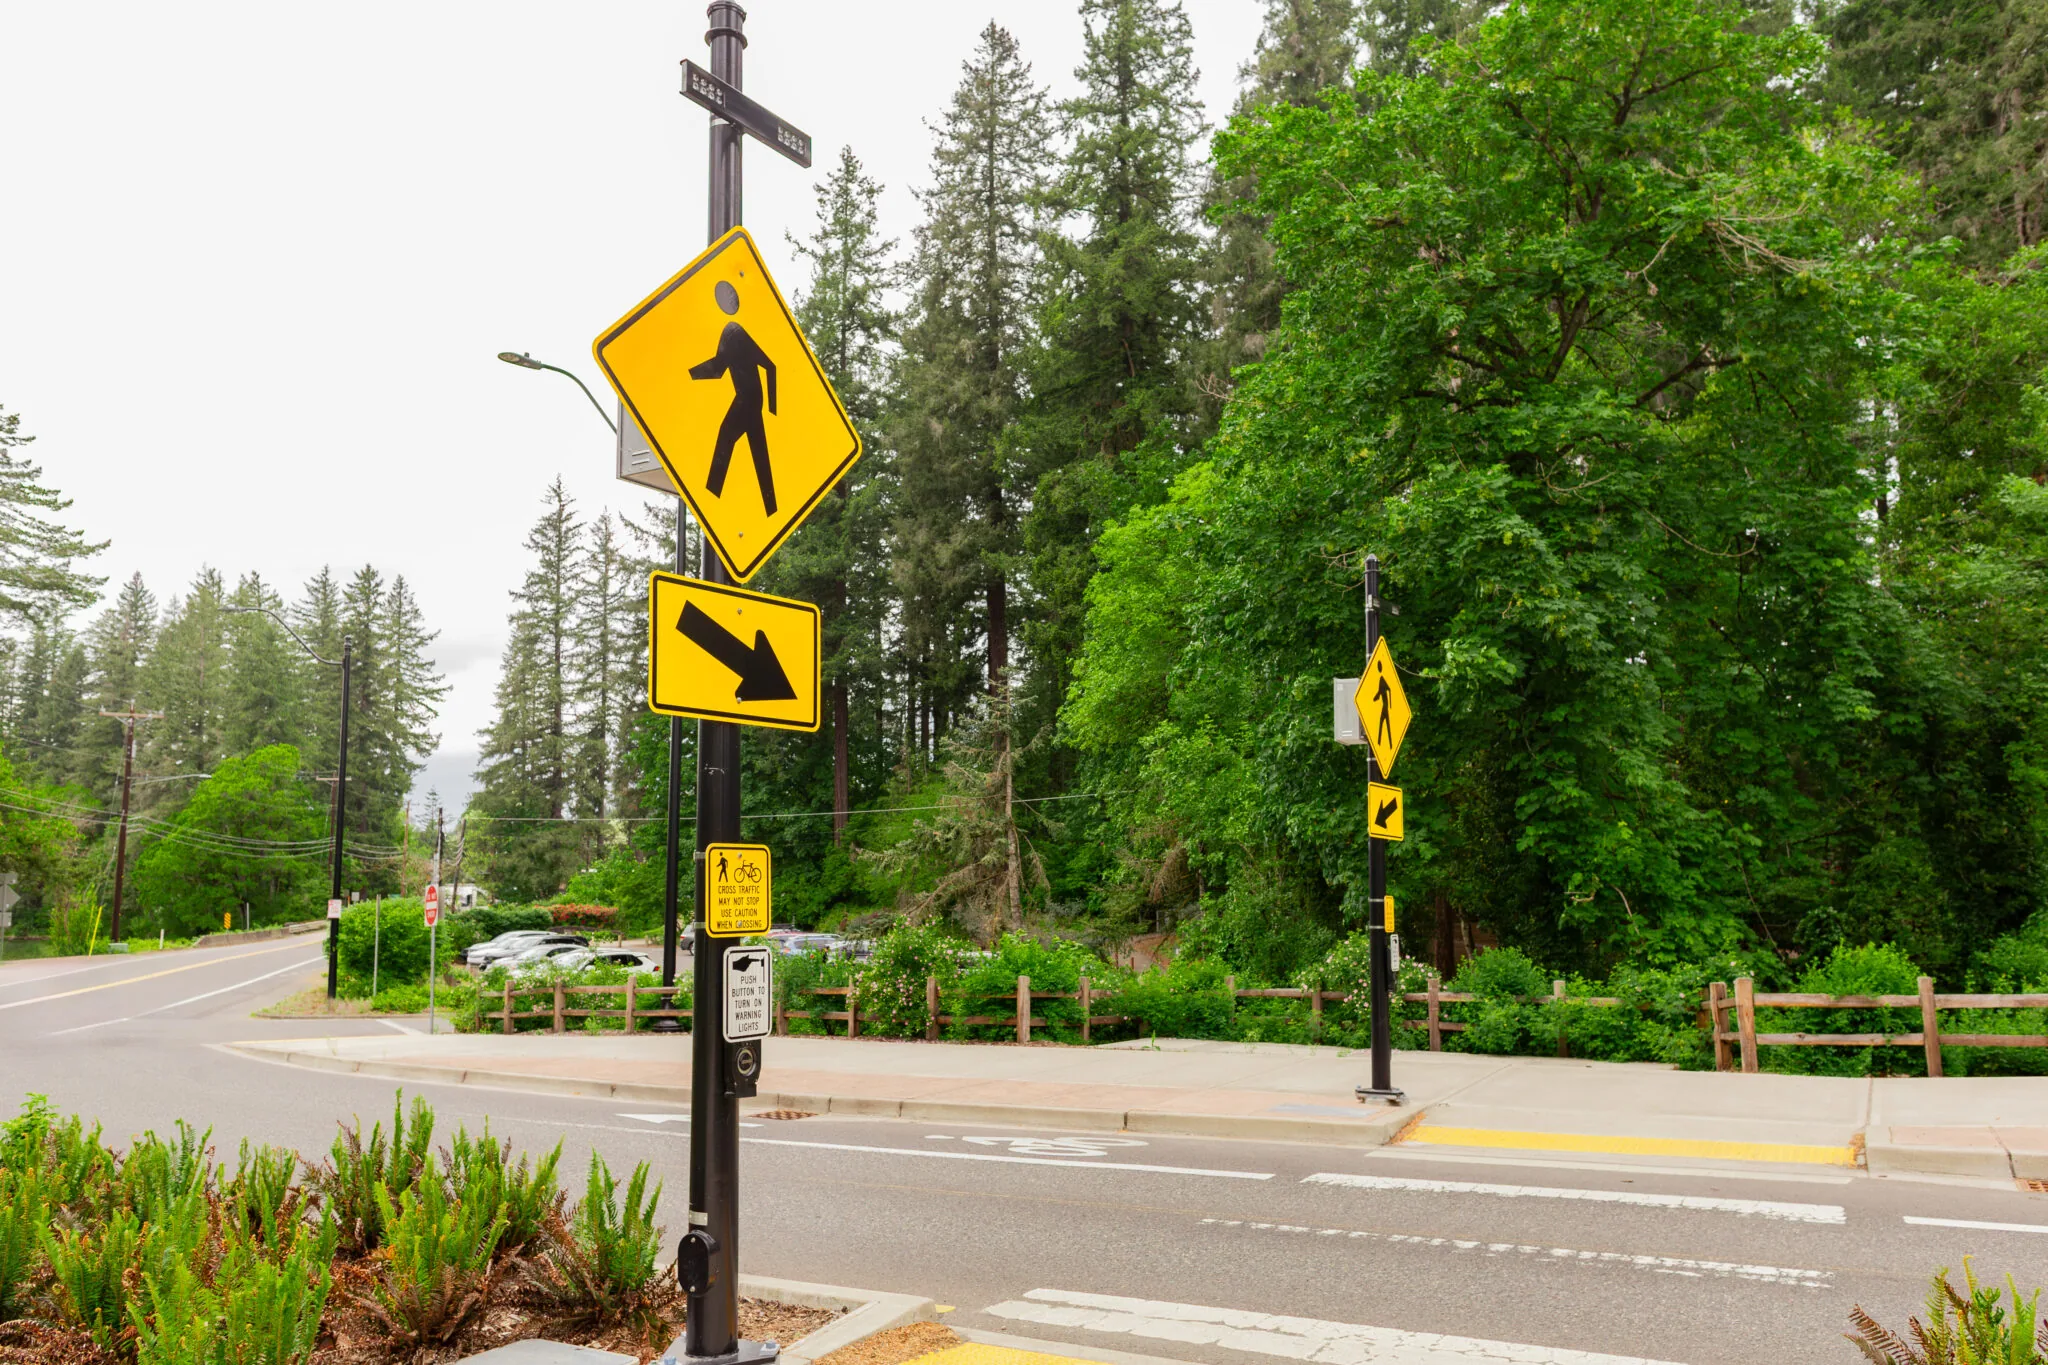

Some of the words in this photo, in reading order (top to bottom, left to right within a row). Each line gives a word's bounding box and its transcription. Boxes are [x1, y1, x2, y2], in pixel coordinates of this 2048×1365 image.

[718, 885, 736, 894] CROSS
[738, 885, 760, 894] TRAFFIC
[718, 897, 731, 906] MAY
[733, 896, 744, 906] NOT
[746, 896, 760, 905] STOP
[720, 908, 732, 917] USE
[734, 908, 758, 917] CAUTION
[717, 920, 733, 929] WHEN
[735, 919, 762, 928] COSSING
[740, 975, 757, 985] PUSH
[731, 987, 755, 997] BUTTON
[758, 985, 766, 995] TO
[735, 999, 750, 1009] TURN
[753, 998, 762, 1007] ON
[735, 1009, 762, 1020] WARNING
[738, 1021, 759, 1033] LIGHTS
